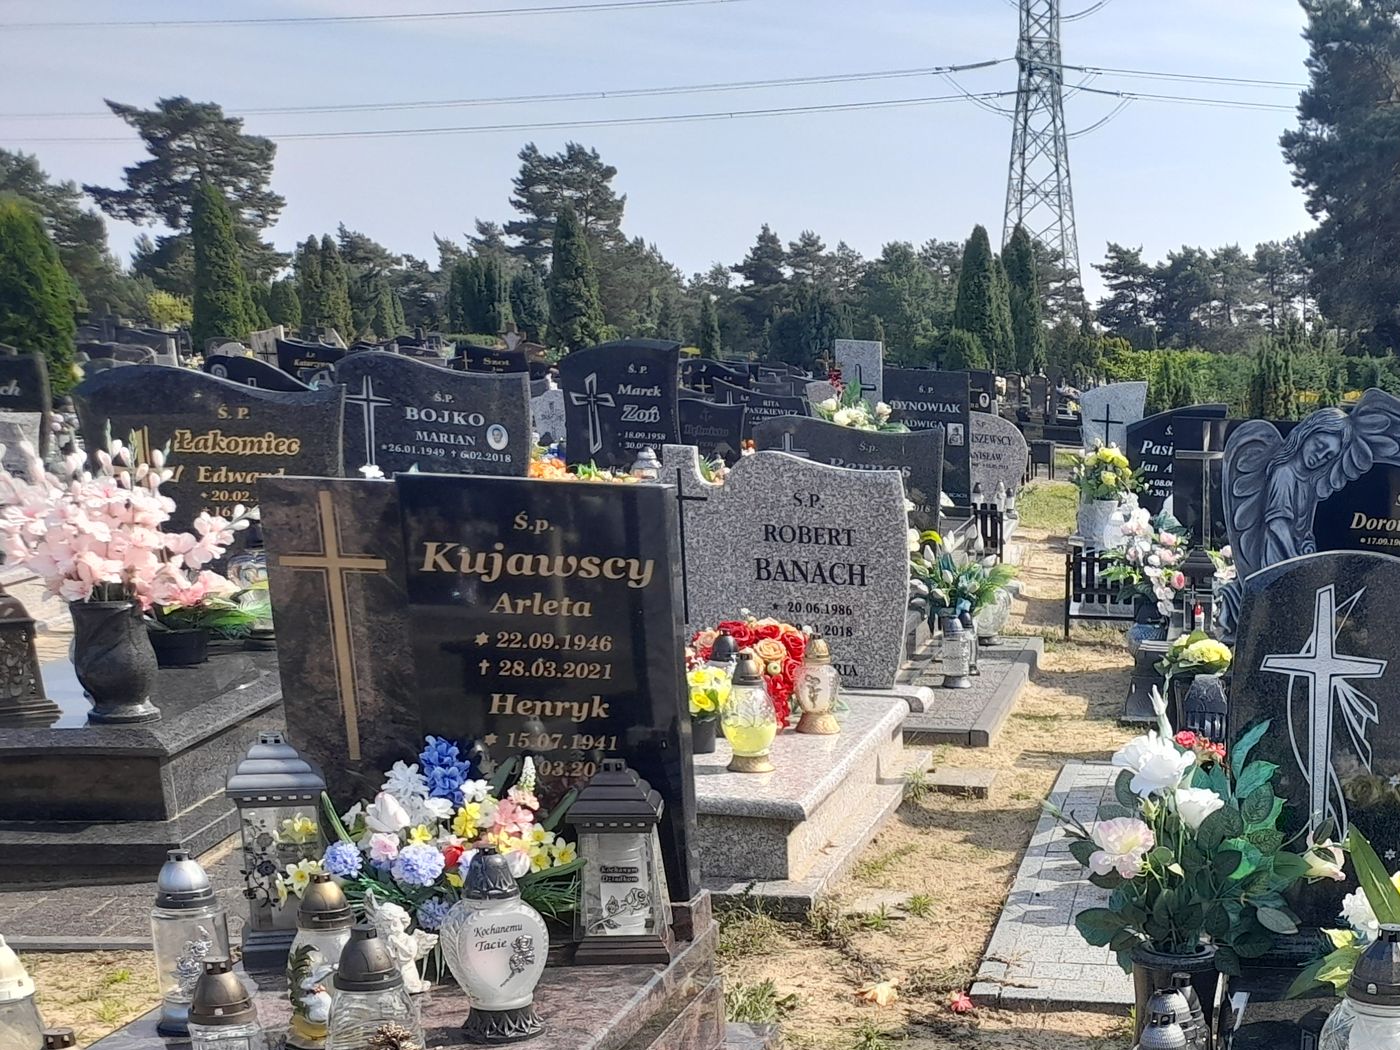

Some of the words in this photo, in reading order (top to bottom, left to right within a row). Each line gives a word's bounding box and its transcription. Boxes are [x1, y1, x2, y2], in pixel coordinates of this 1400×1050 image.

[640, 365, 648, 374] P.
[434, 391, 455, 403] Ś.P.
[618, 384, 662, 397] Marek
[218, 403, 231, 419] Ś.
[237, 407, 250, 419] P.
[405, 406, 485, 427] BOJKO
[621, 404, 660, 423] Zoń
[174, 429, 300, 455] Łakomiec
[416, 430, 477, 446] MARIAN
[389, 443, 446, 458] 26.01.1949
[1140, 440, 1174, 456] Pasi
[513, 510, 555, 535] Ś.p.
[764, 524, 856, 547] ROBERT
[419, 541, 655, 589] Kujawscy
[754, 557, 868, 586] BANACH
[489, 592, 593, 618] Arleta
[788, 602, 852, 616] 20.06.1986
[496, 631, 613, 653] 22.09.1946
[499, 659, 612, 681] 28.03.2021
[488, 693, 610, 723] Henryk
[507, 732, 618, 751] 15.07.1941
[473, 923, 523, 938] Kochanemu
[475, 939, 508, 952] Tacie
